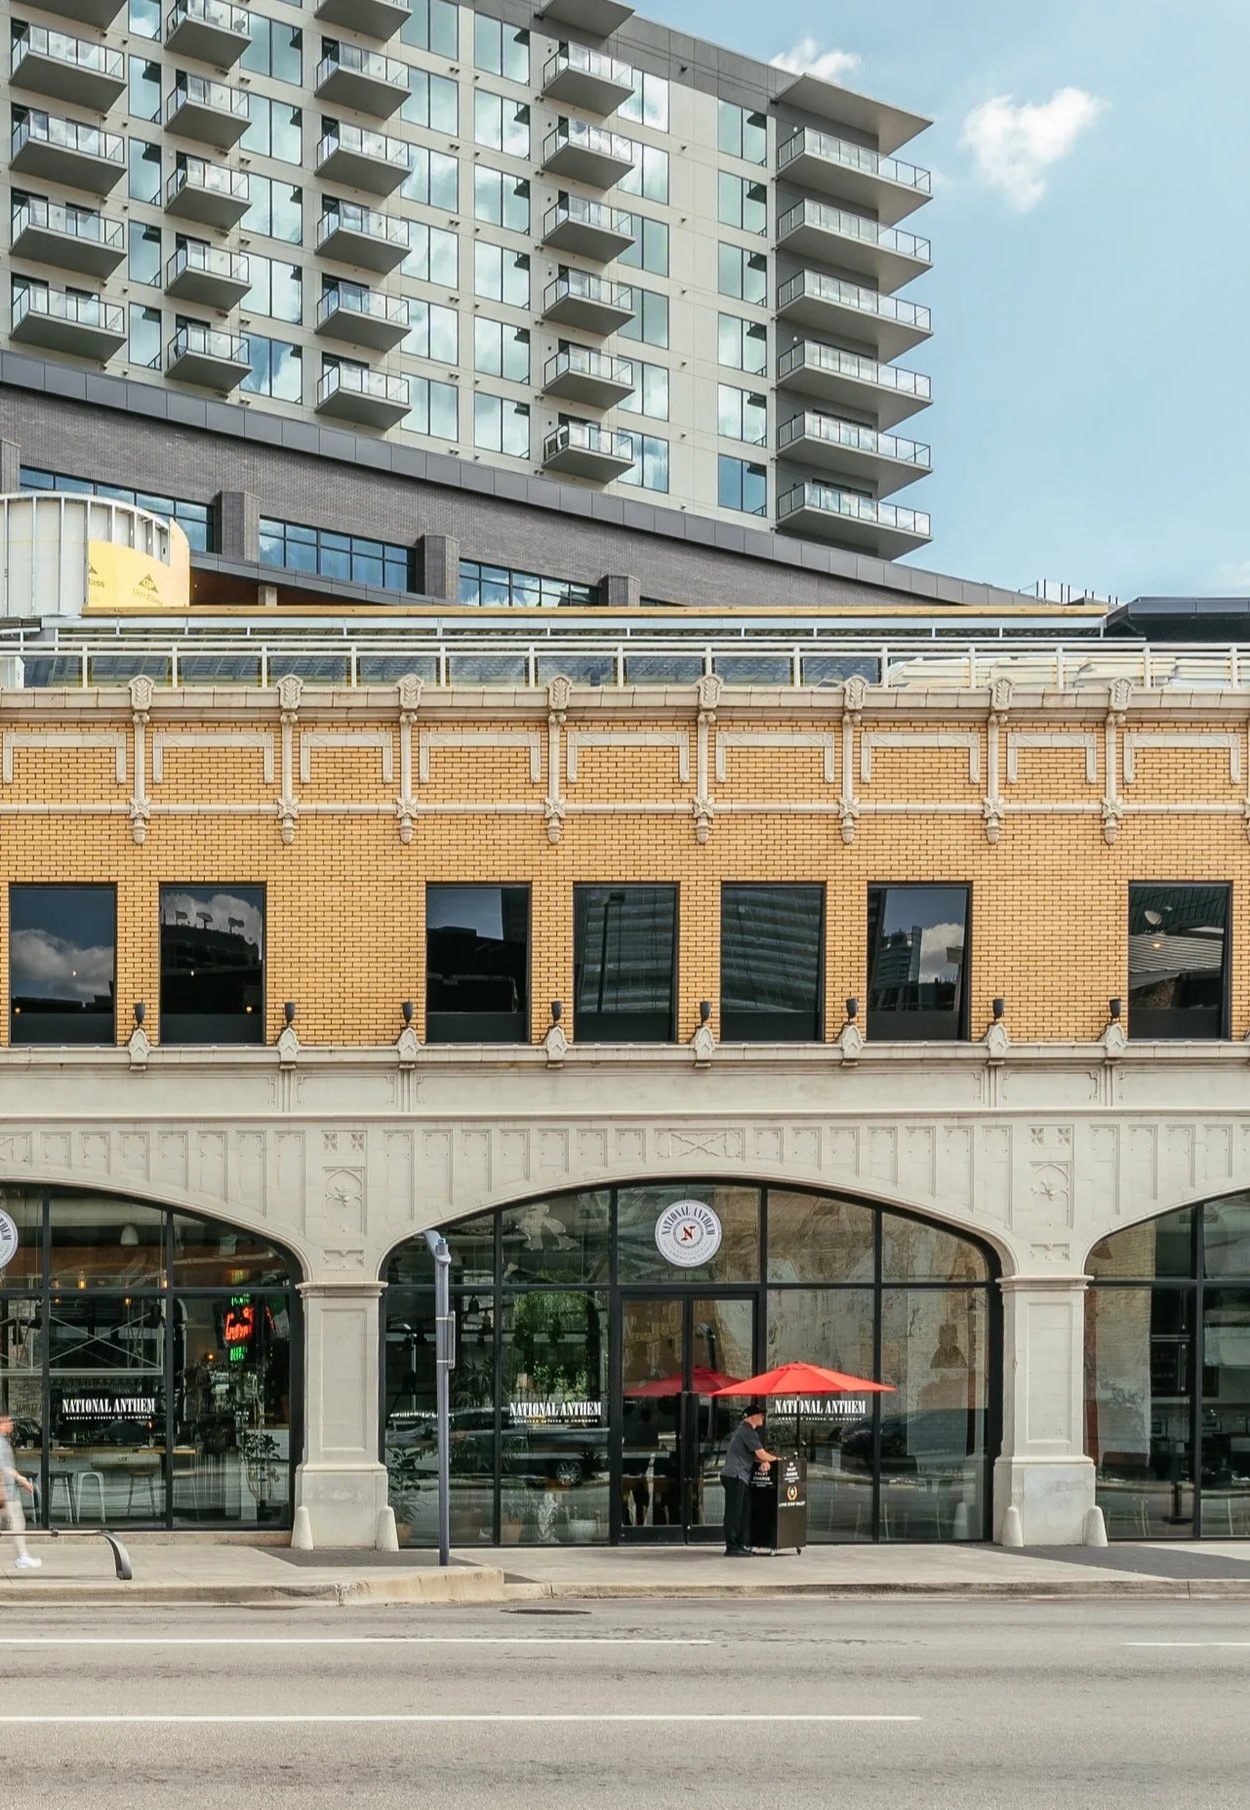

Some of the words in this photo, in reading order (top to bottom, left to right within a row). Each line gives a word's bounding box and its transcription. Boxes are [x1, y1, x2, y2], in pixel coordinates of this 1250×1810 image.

[62, 1398, 111, 1414] NATIONAL
[113, 1397, 155, 1413] ANTHEM
[509, 1402, 558, 1416] NATIONAL
[560, 1401, 601, 1416] ANTHEM
[774, 1399, 823, 1414] NATIONAL
[825, 1399, 866, 1414] ANTHEM
